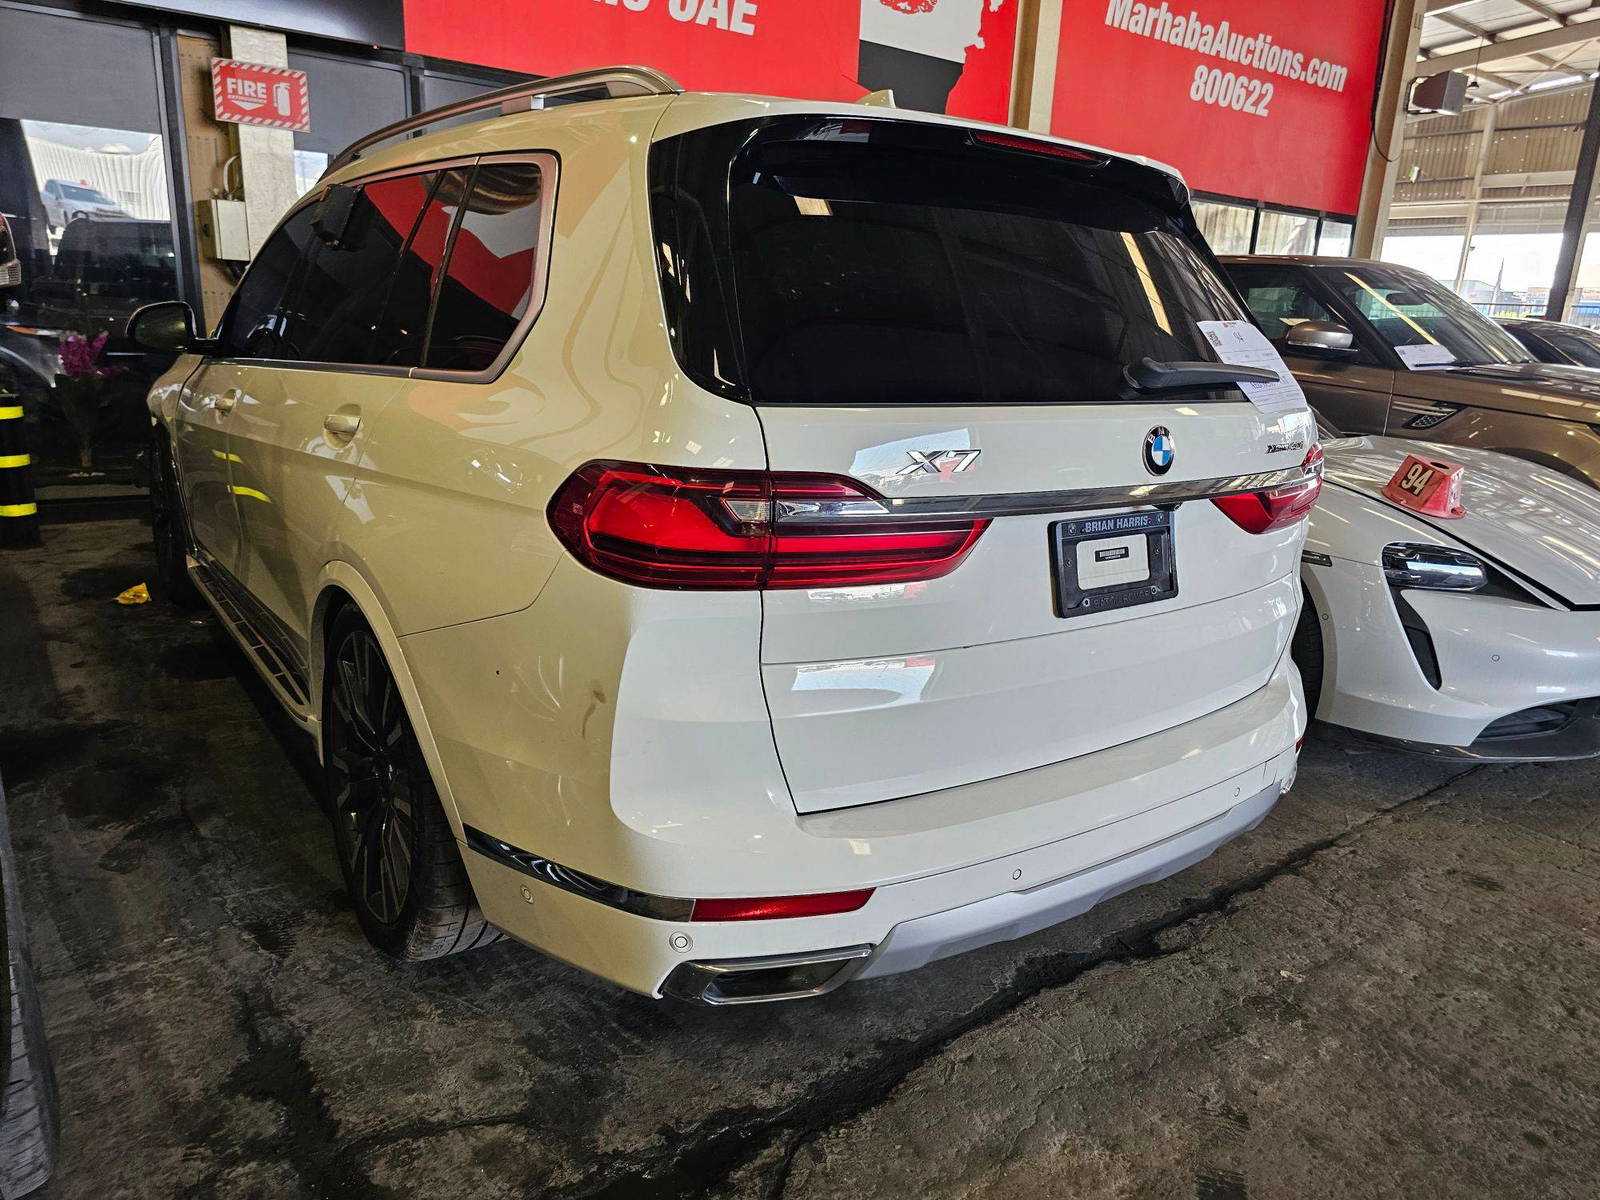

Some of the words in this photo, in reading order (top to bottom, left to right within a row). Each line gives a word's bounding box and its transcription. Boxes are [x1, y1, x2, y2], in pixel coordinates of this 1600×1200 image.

[667, 0, 758, 36] UAE
[1105, 0, 1348, 92] MarhabaAuctions.com
[226, 77, 267, 98] FIRE
[1190, 65, 1274, 117] 800622
[895, 449, 981, 474] X7
[1401, 463, 1434, 496] 94
[1084, 519, 1115, 532] BRIAN
[1116, 515, 1148, 528] HARRIS
